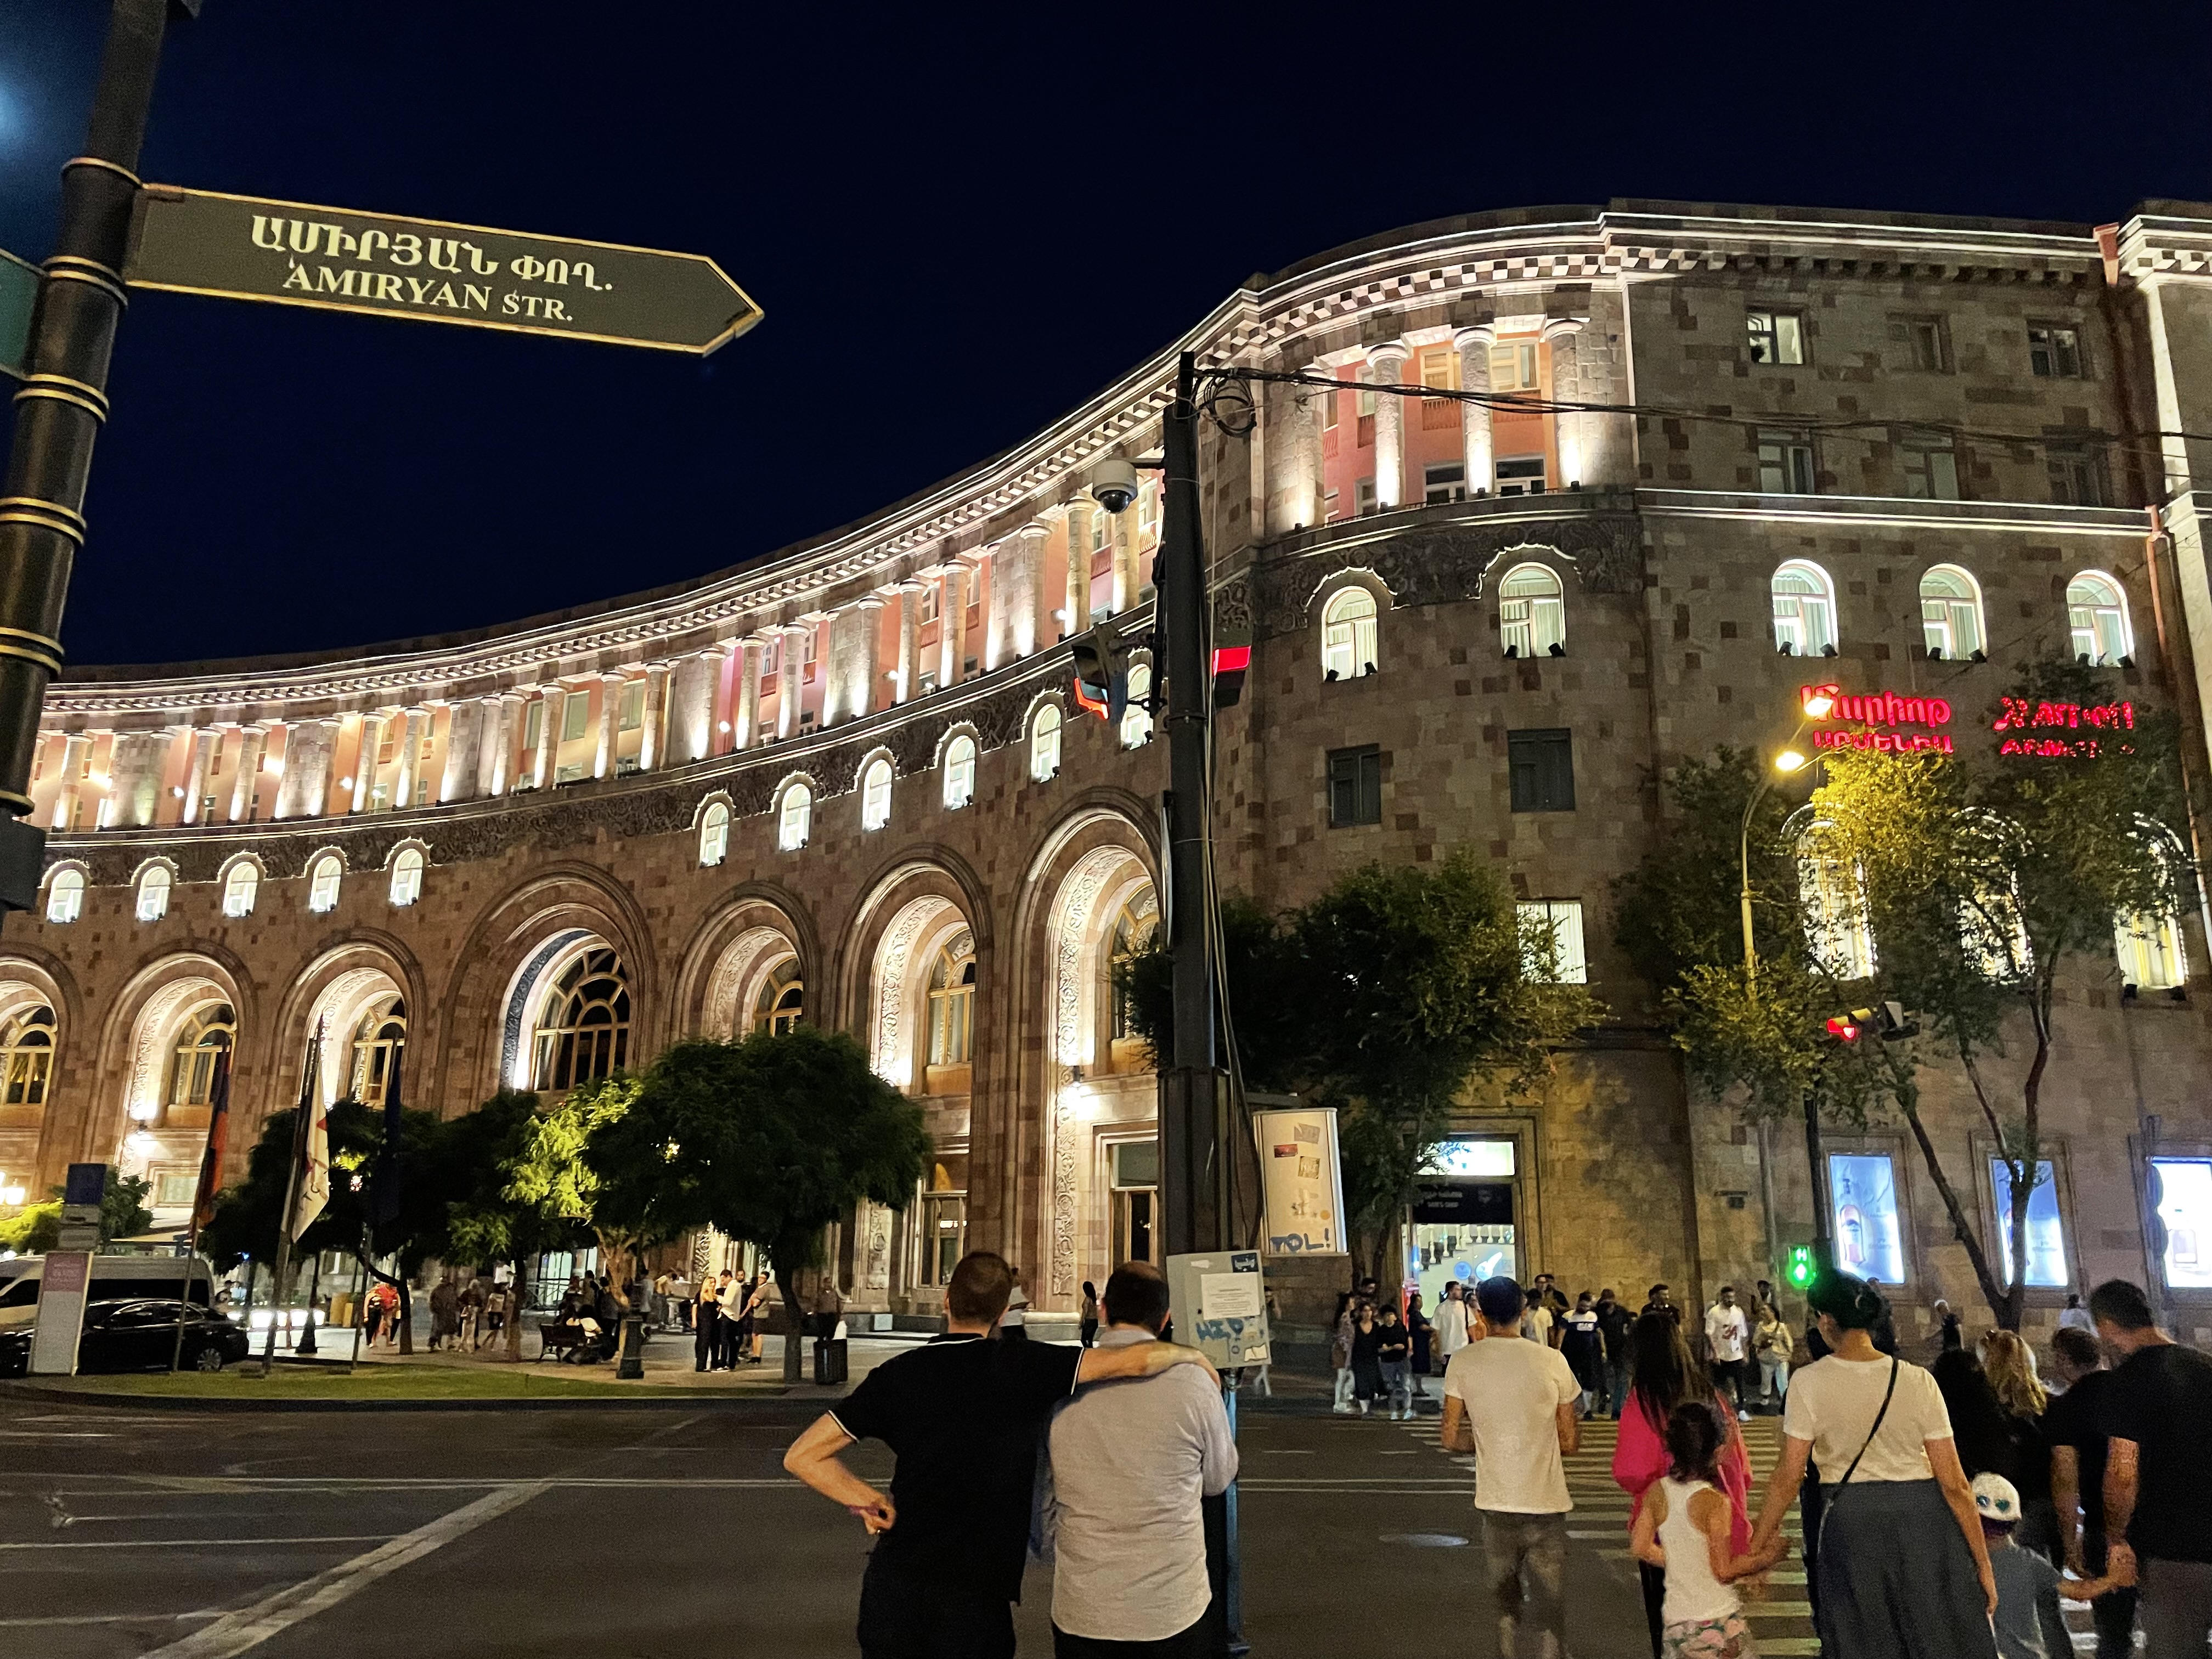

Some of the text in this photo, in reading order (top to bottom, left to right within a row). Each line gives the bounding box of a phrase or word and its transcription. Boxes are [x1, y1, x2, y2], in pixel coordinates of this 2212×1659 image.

[252, 215, 612, 291] ԱՄԻՐՅԱՆ ՓՈՂ.
[282, 263, 573, 321] AMIRYAN STR.
